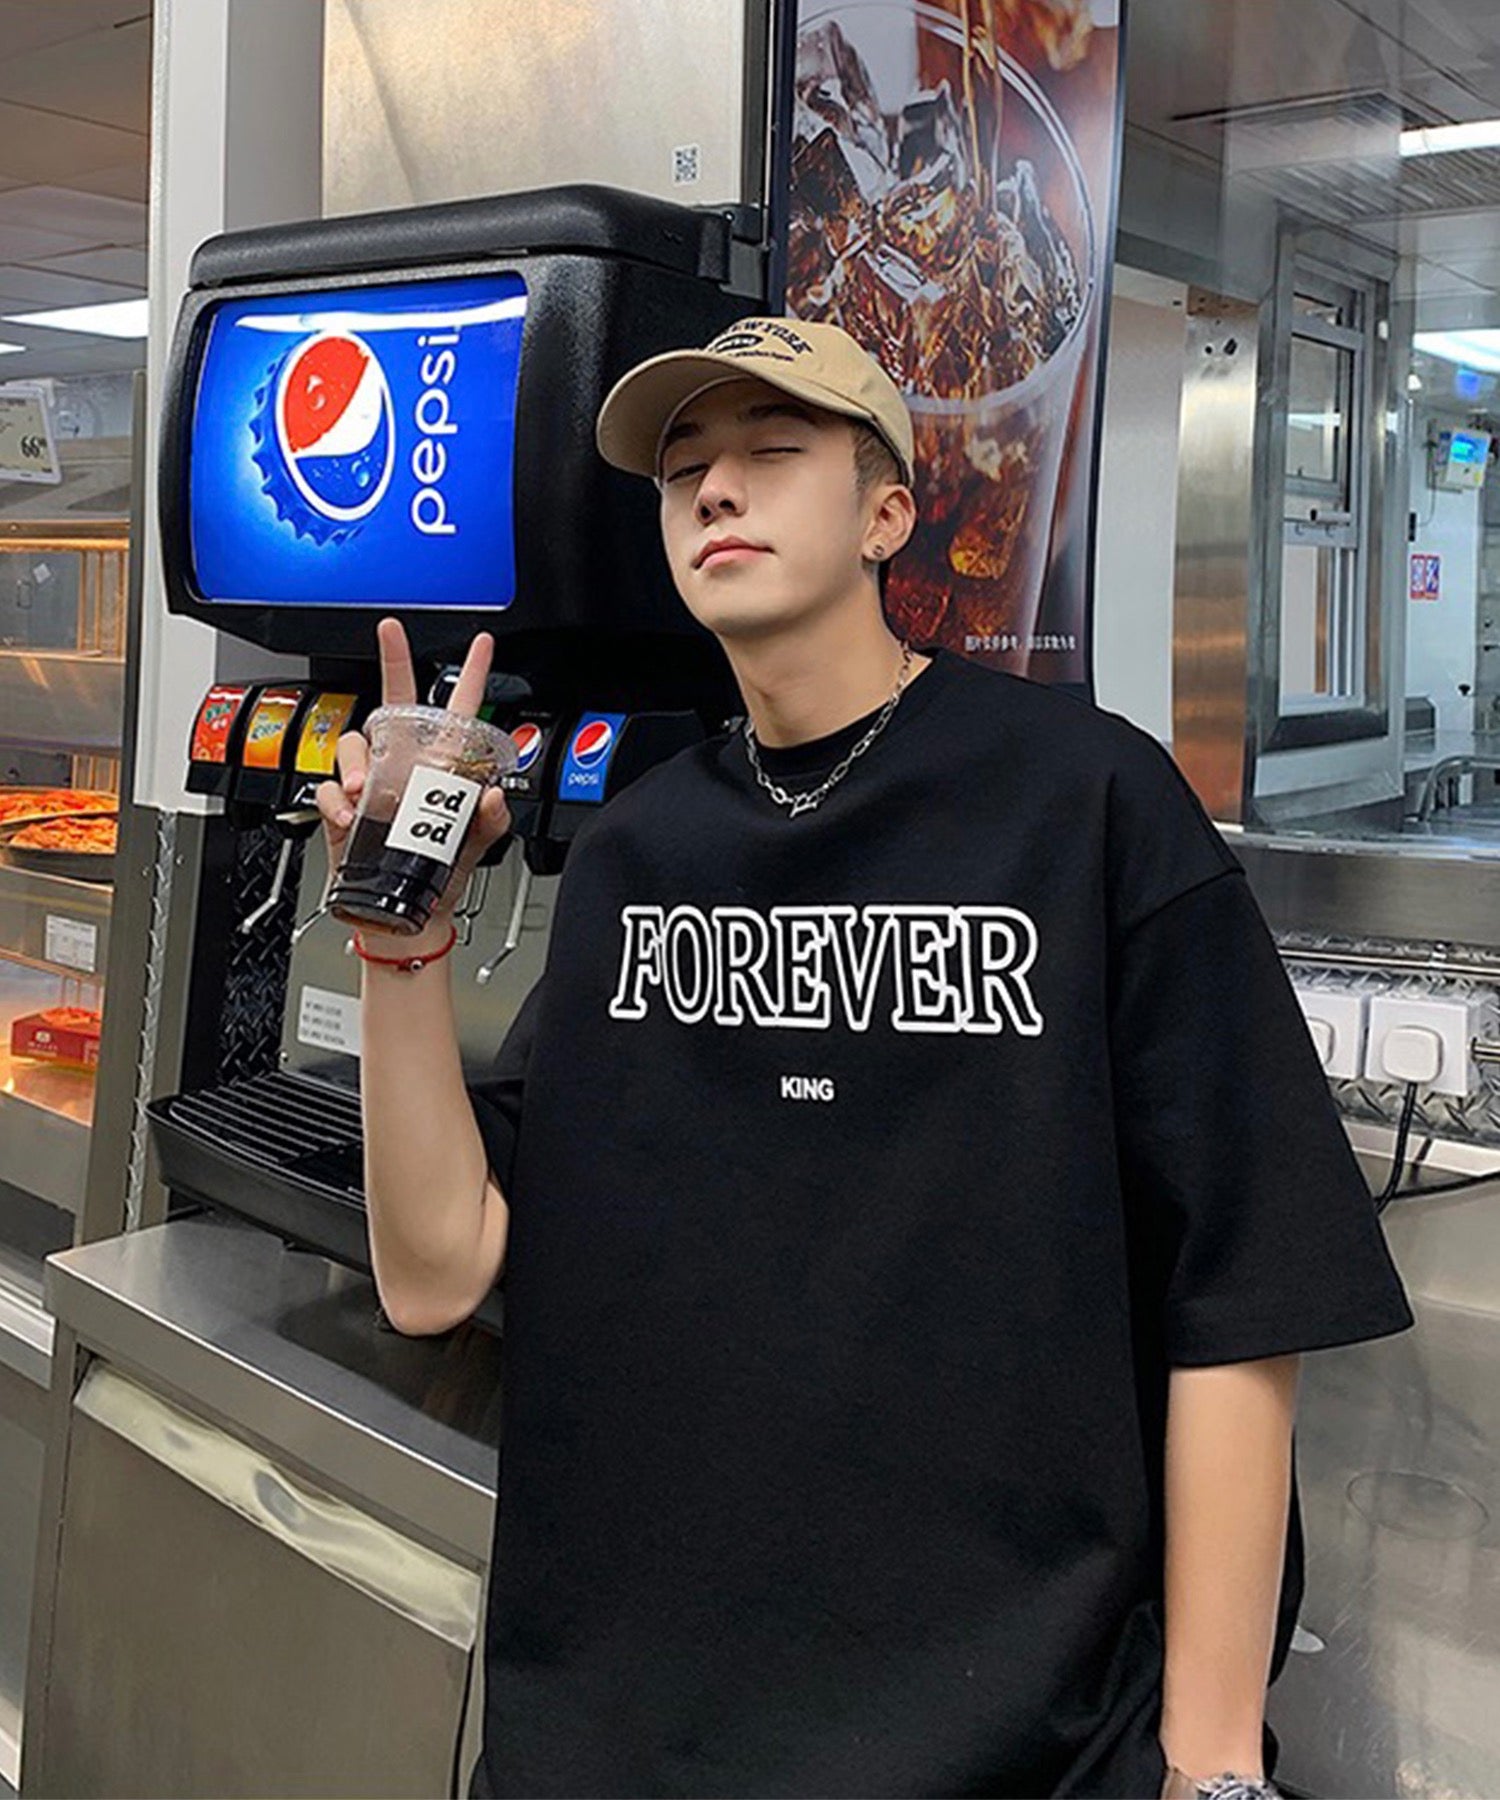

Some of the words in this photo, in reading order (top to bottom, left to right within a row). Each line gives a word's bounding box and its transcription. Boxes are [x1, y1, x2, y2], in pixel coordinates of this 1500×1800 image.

[411, 334, 460, 535] pepsi
[425, 789, 467, 813] od
[410, 822, 453, 845] od
[609, 906, 1043, 1035] FOREVER
[781, 1076, 835, 1100] KING
